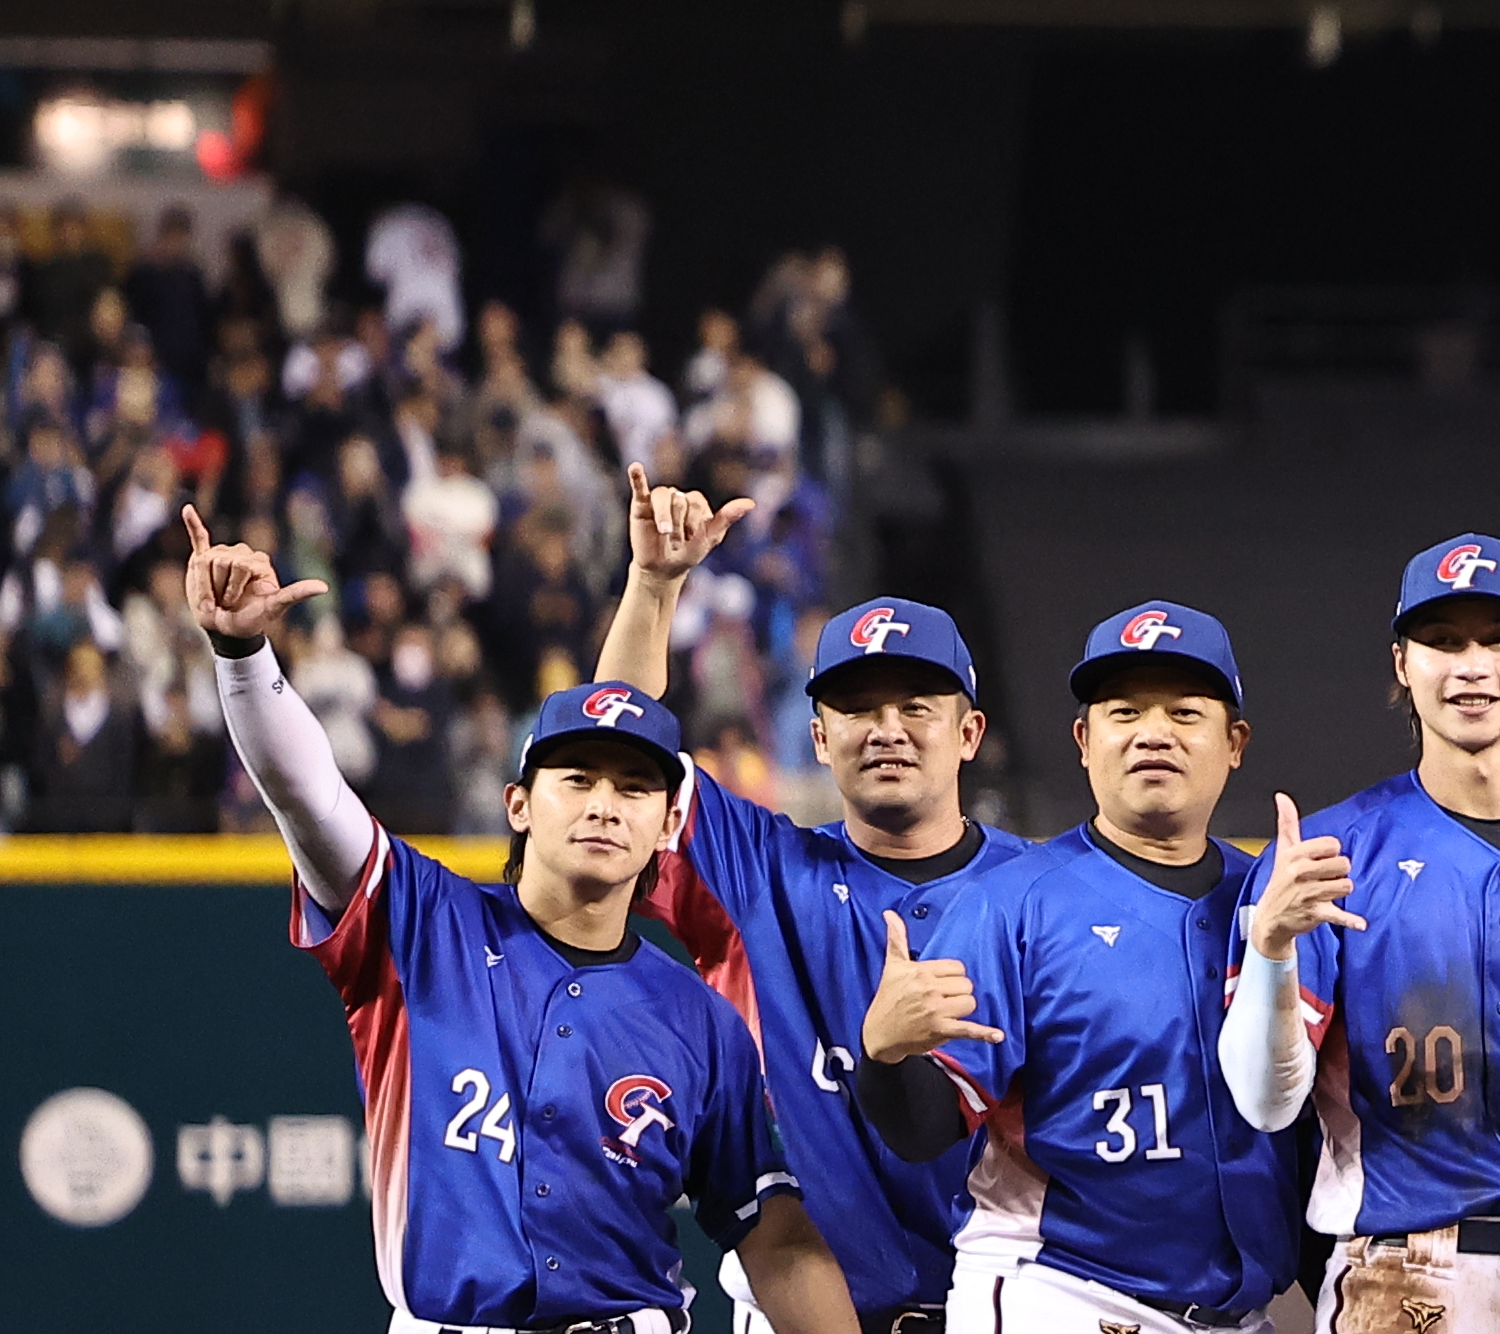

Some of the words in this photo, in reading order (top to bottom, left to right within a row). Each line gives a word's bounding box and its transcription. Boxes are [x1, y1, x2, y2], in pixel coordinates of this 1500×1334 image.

[1385, 1025, 1464, 1107] 20
[443, 1068, 516, 1163] 24
[1093, 1083, 1181, 1162] 31
